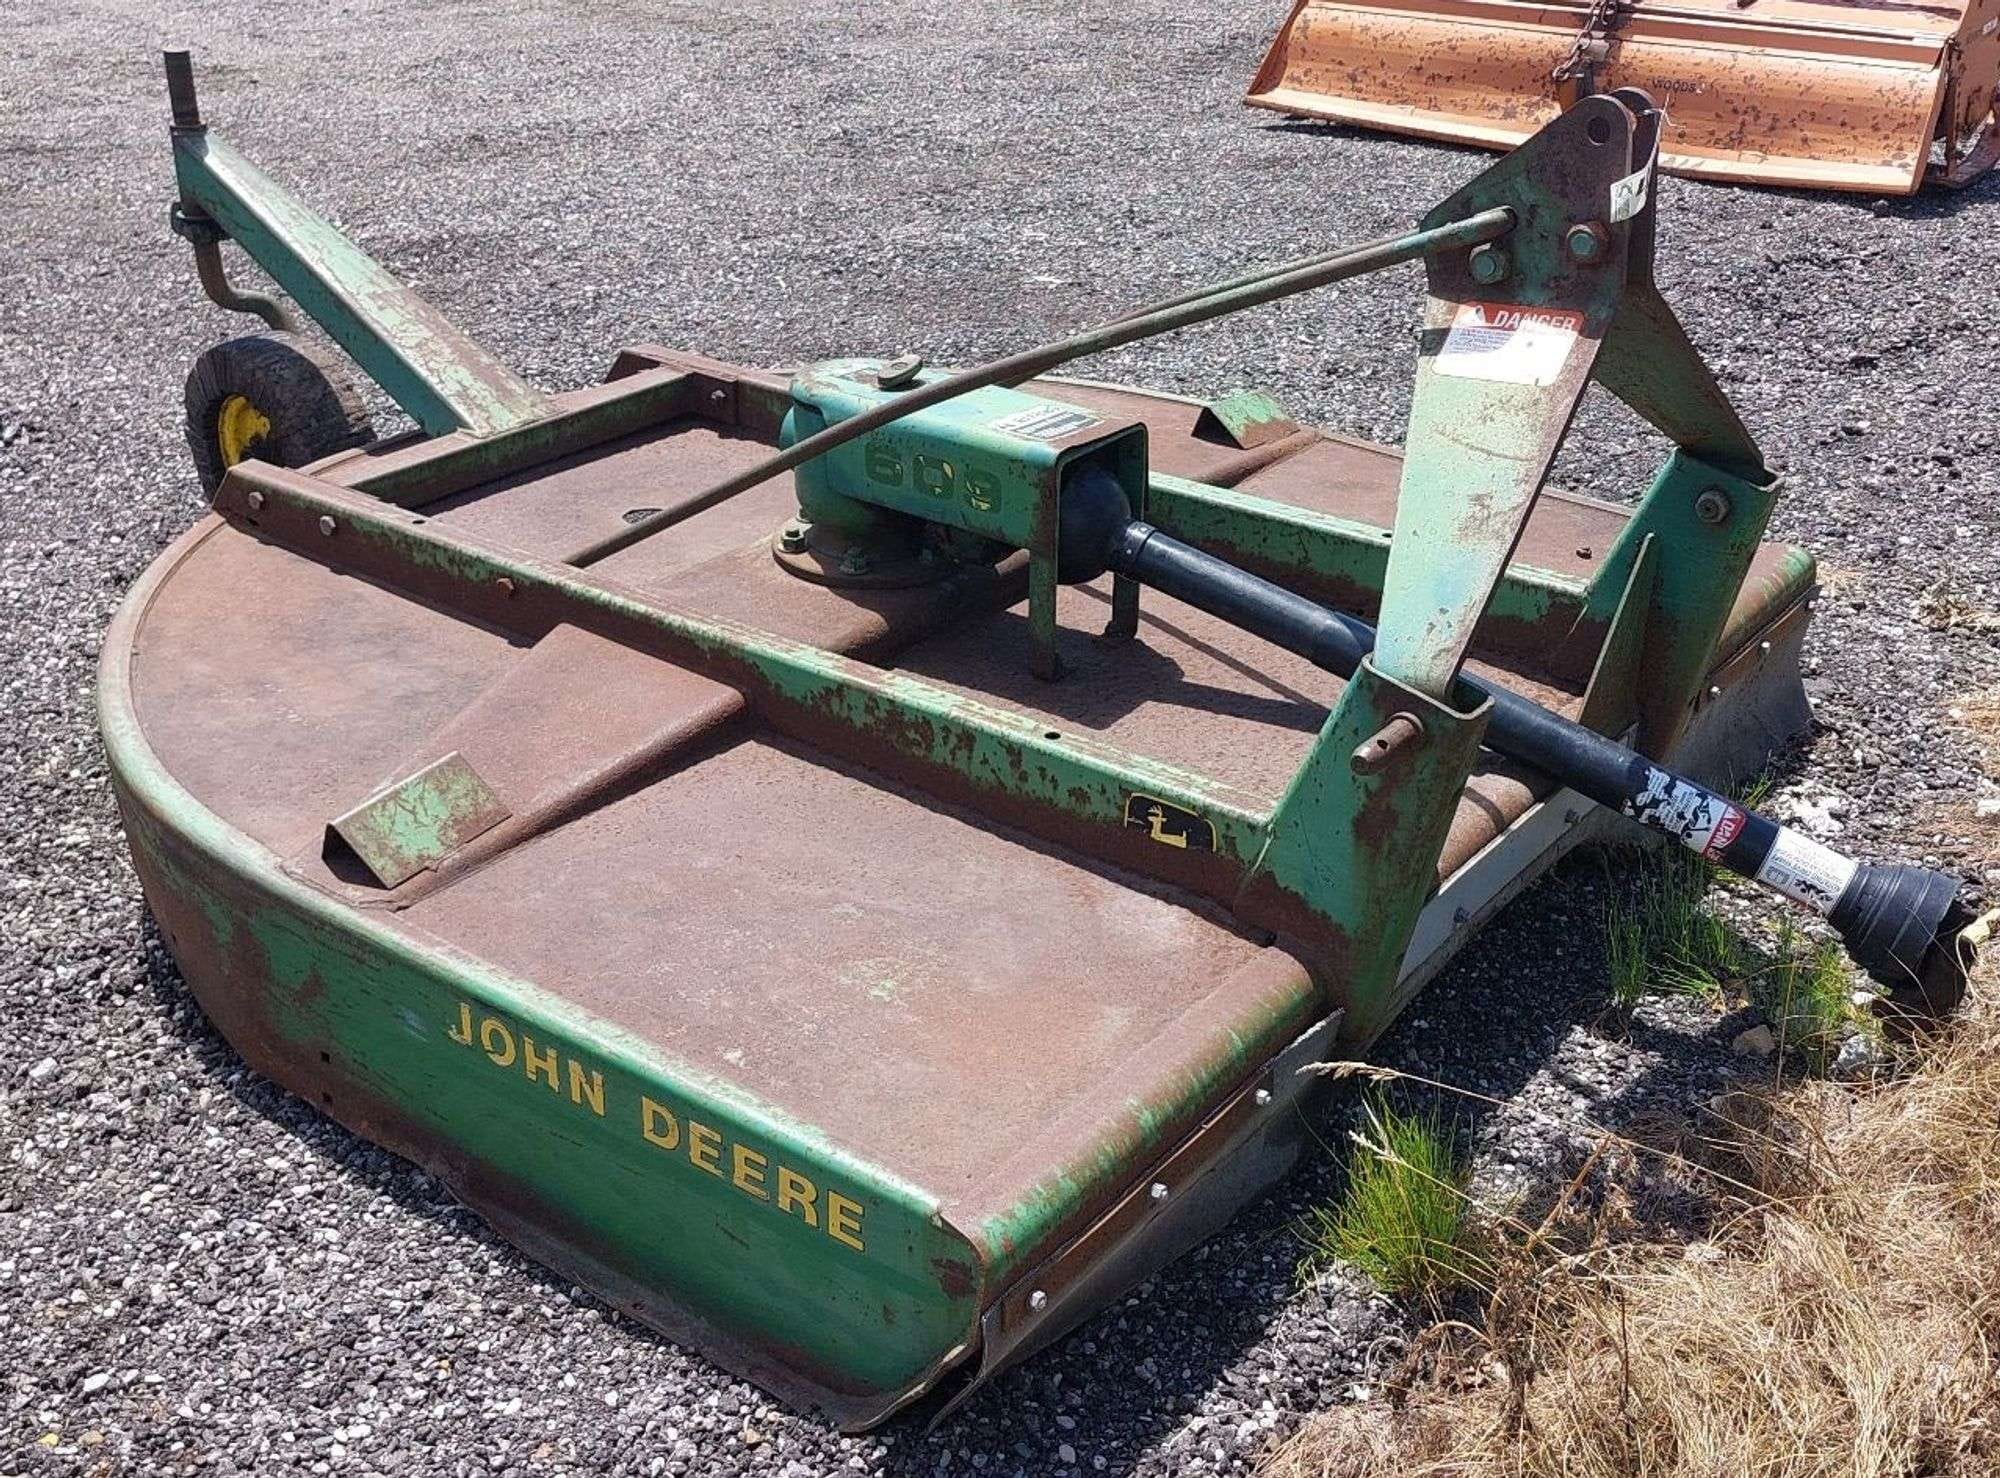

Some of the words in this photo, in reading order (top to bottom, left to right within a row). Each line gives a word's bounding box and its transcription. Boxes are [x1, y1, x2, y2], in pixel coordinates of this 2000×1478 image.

[1652, 79, 1697, 93] WOODS
[1493, 310, 1577, 331] DANGER
[448, 1002, 606, 1117] JOHN
[641, 1095, 866, 1253] DEERE
